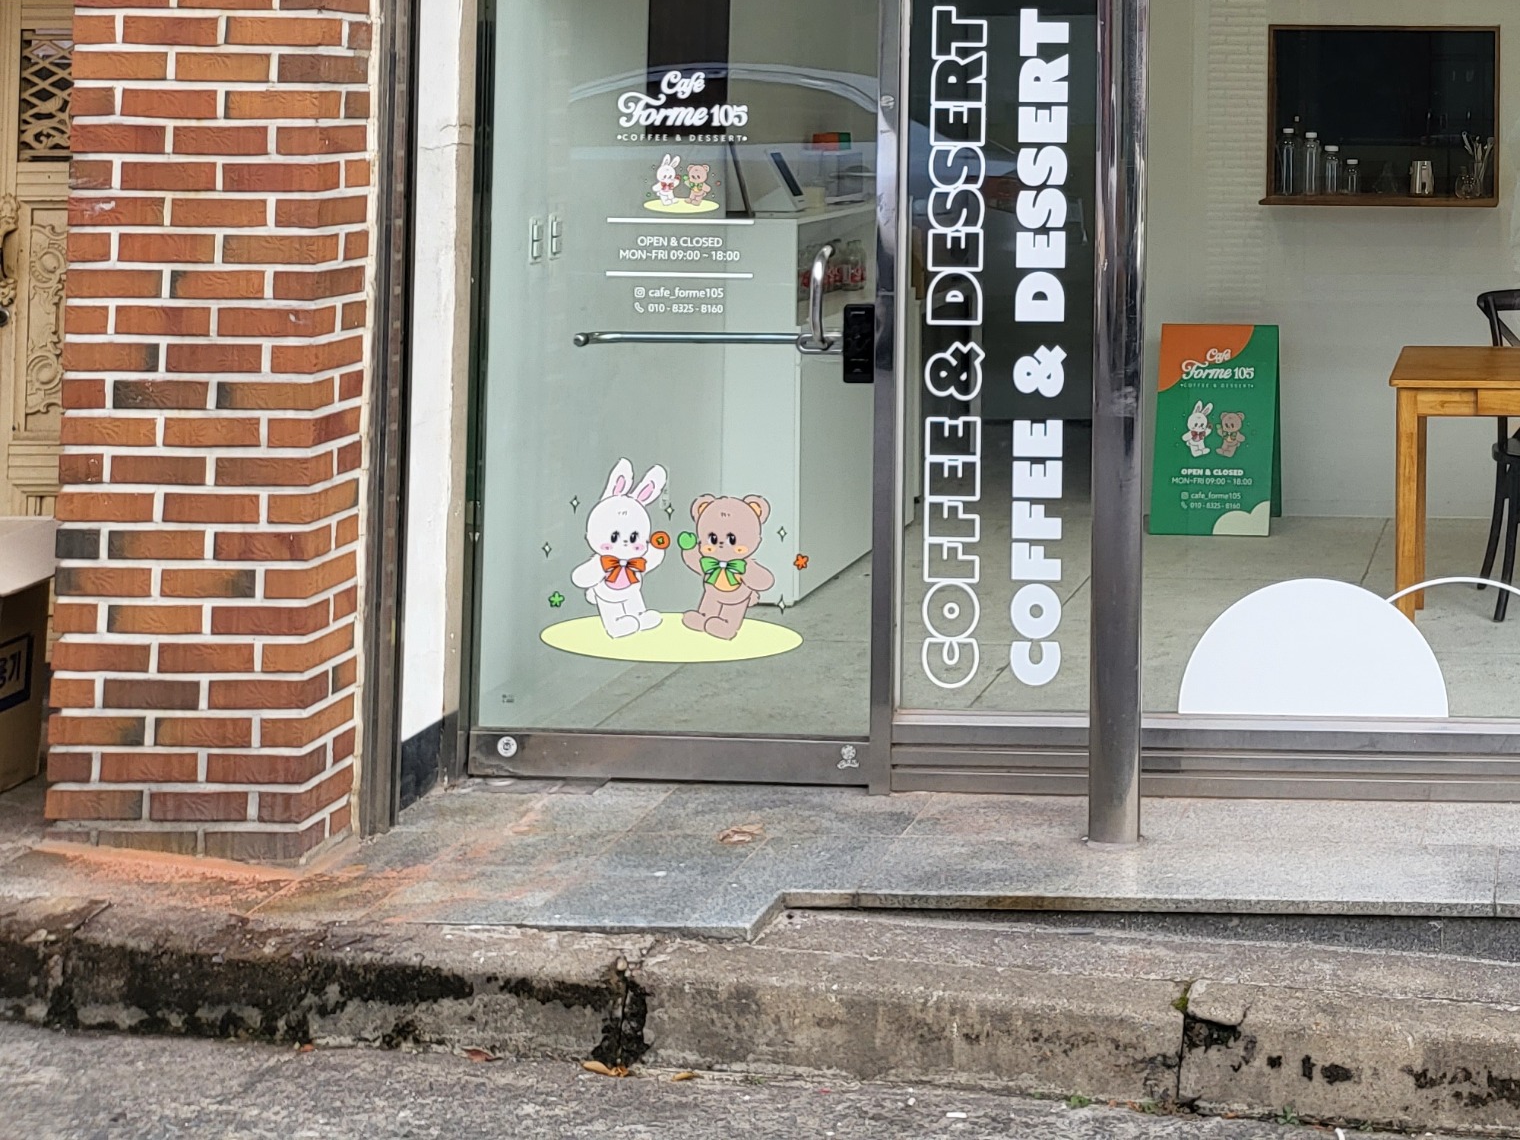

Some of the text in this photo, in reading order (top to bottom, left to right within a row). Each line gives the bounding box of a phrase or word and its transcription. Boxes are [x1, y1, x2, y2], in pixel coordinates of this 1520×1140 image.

[617, 91, 749, 128] Forme 105
[622, 133, 743, 142] COFFEE & DESSERT
[637, 236, 723, 248] OPEN & CLOSED
[619, 249, 668, 260] MON~FRI
[669, 250, 700, 260] 09:00
[711, 251, 740, 261] 18:00
[648, 287, 724, 299] cafe_forme105
[922, 5, 988, 689] COFFEE & DESSERT
[1010, 8, 1070, 686] COFFEE & DESSERT
[1181, 359, 1255, 380] Forme 105
[1180, 468, 1204, 476] OPEN
[1213, 468, 1244, 476] CLOSED
